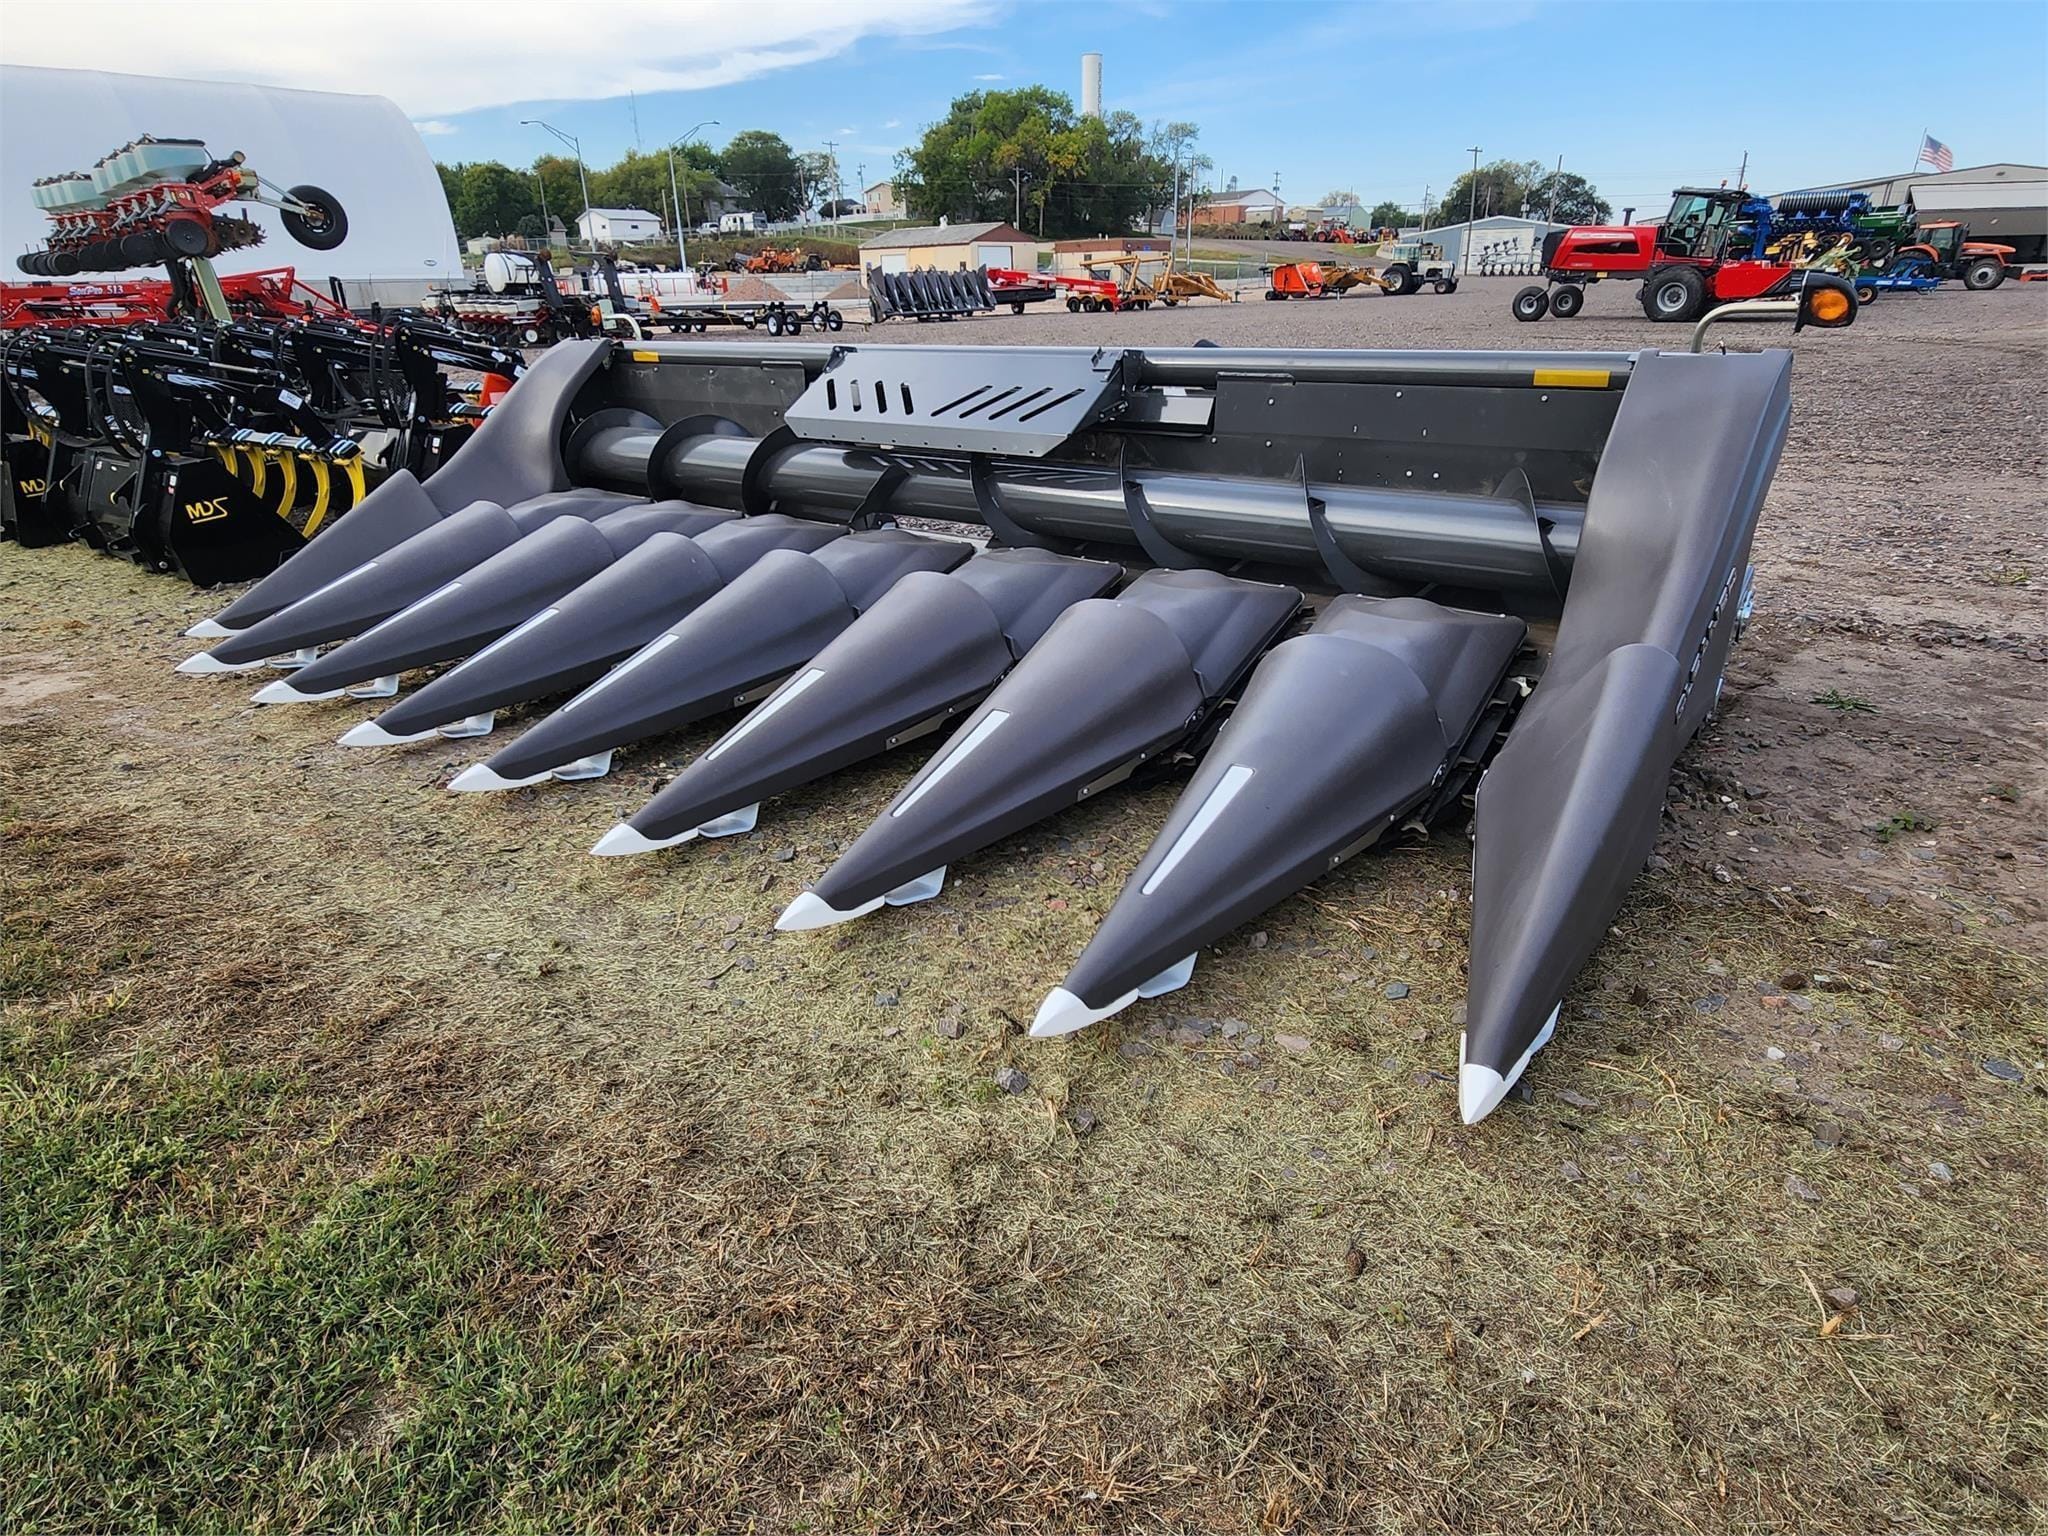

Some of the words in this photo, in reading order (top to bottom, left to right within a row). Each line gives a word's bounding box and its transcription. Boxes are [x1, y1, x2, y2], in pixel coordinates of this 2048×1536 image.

[106, 285, 124, 295] 513
[20, 478, 46, 498] MD
[185, 496, 229, 524] MDS
